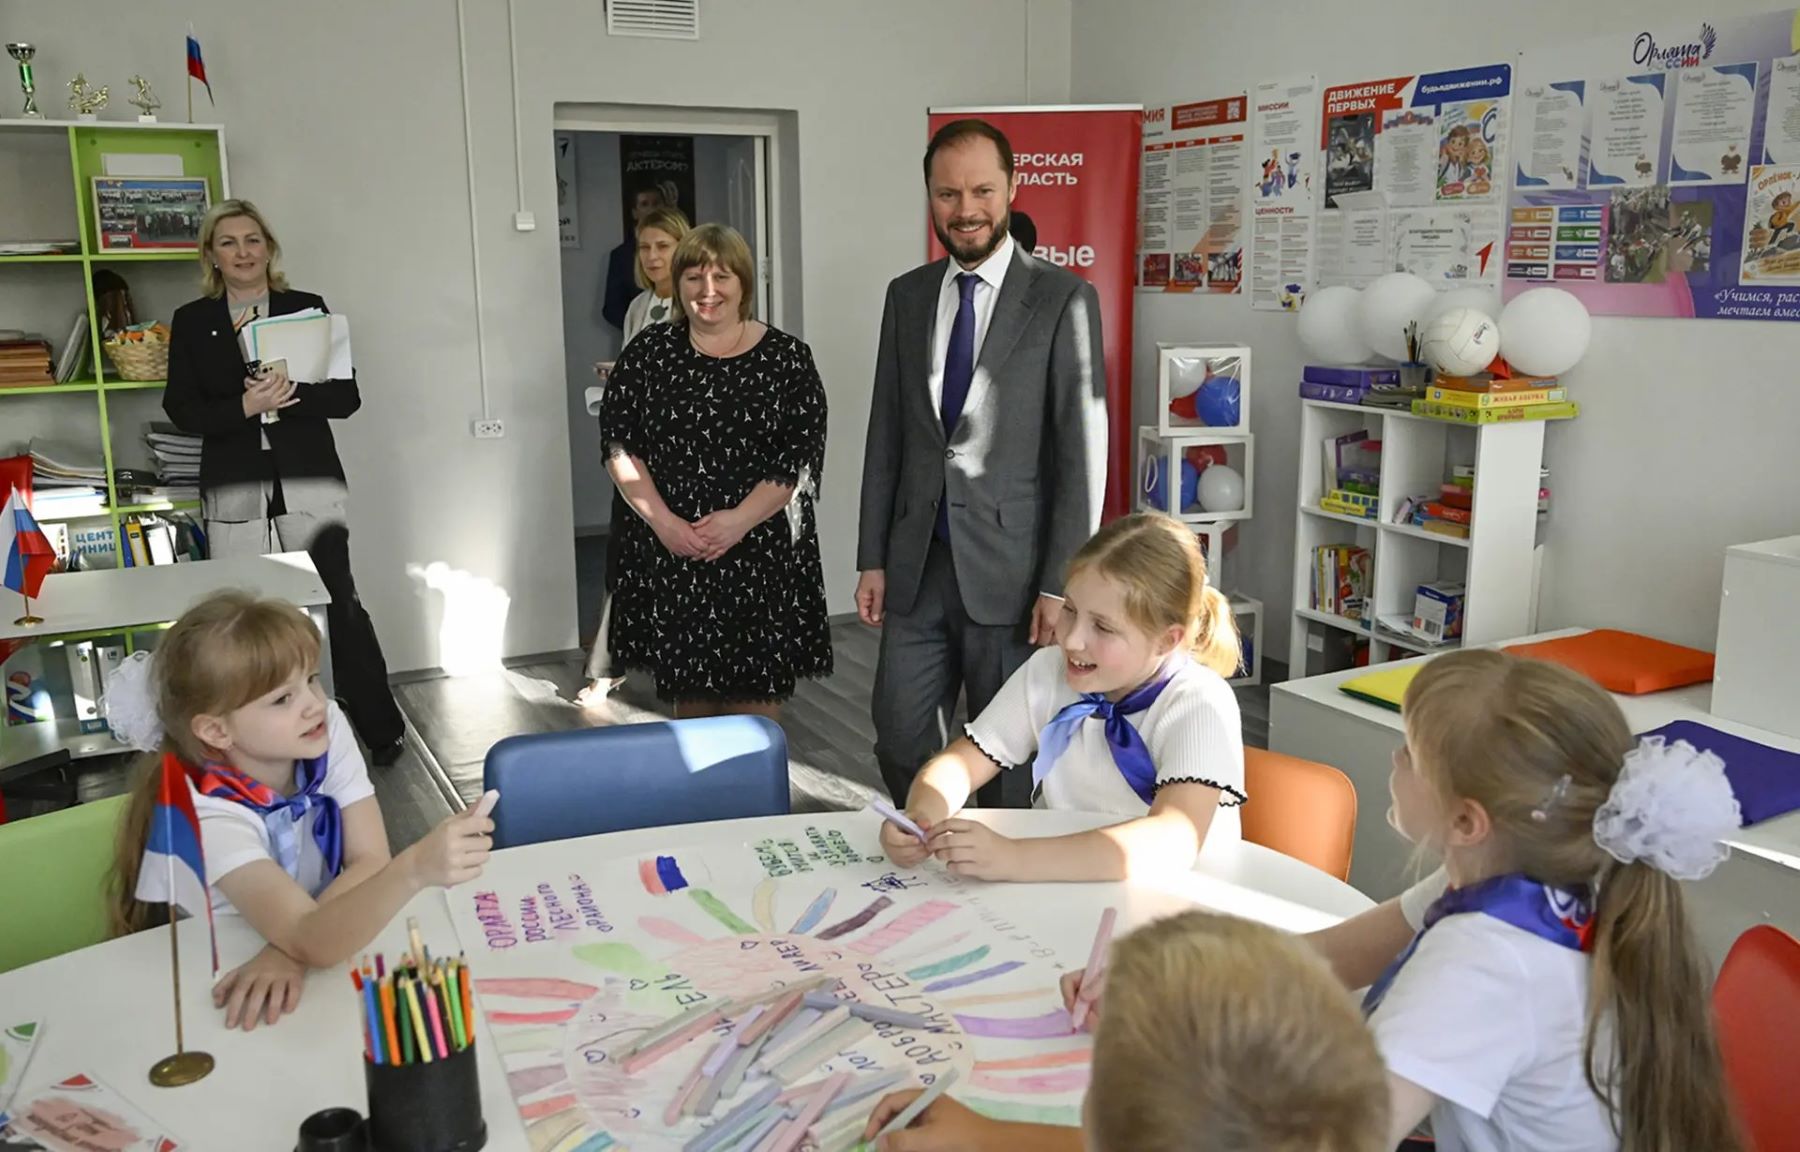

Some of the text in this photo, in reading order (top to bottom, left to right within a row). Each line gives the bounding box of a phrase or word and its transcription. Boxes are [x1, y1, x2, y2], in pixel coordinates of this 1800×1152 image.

[1633, 31, 1702, 67] Орлята
[1328, 83, 1395, 101] ДВИЖЕНИЕ
[1328, 99, 1376, 113] ПЕРВЫХ
[1142, 108, 1164, 124] МИЯ
[1012, 152, 1084, 167] ЕРСКАЯ
[1016, 171, 1078, 186] ЛАСТЬ
[1255, 207, 1294, 216] ЦЕННОСТИ
[1032, 244, 1095, 267] вые
[1714, 288, 1800, 306] «Учимся, рас
[1716, 306, 1772, 317] мечтаем
[537, 884, 580, 930] ЛЕСНОГО
[473, 890, 518, 948] ОРЛЯТА
[520, 897, 554, 942] РОССИИ
[658, 973, 708, 1005] ЕЛЬ
[838, 1050, 884, 1070] ЛОГ
